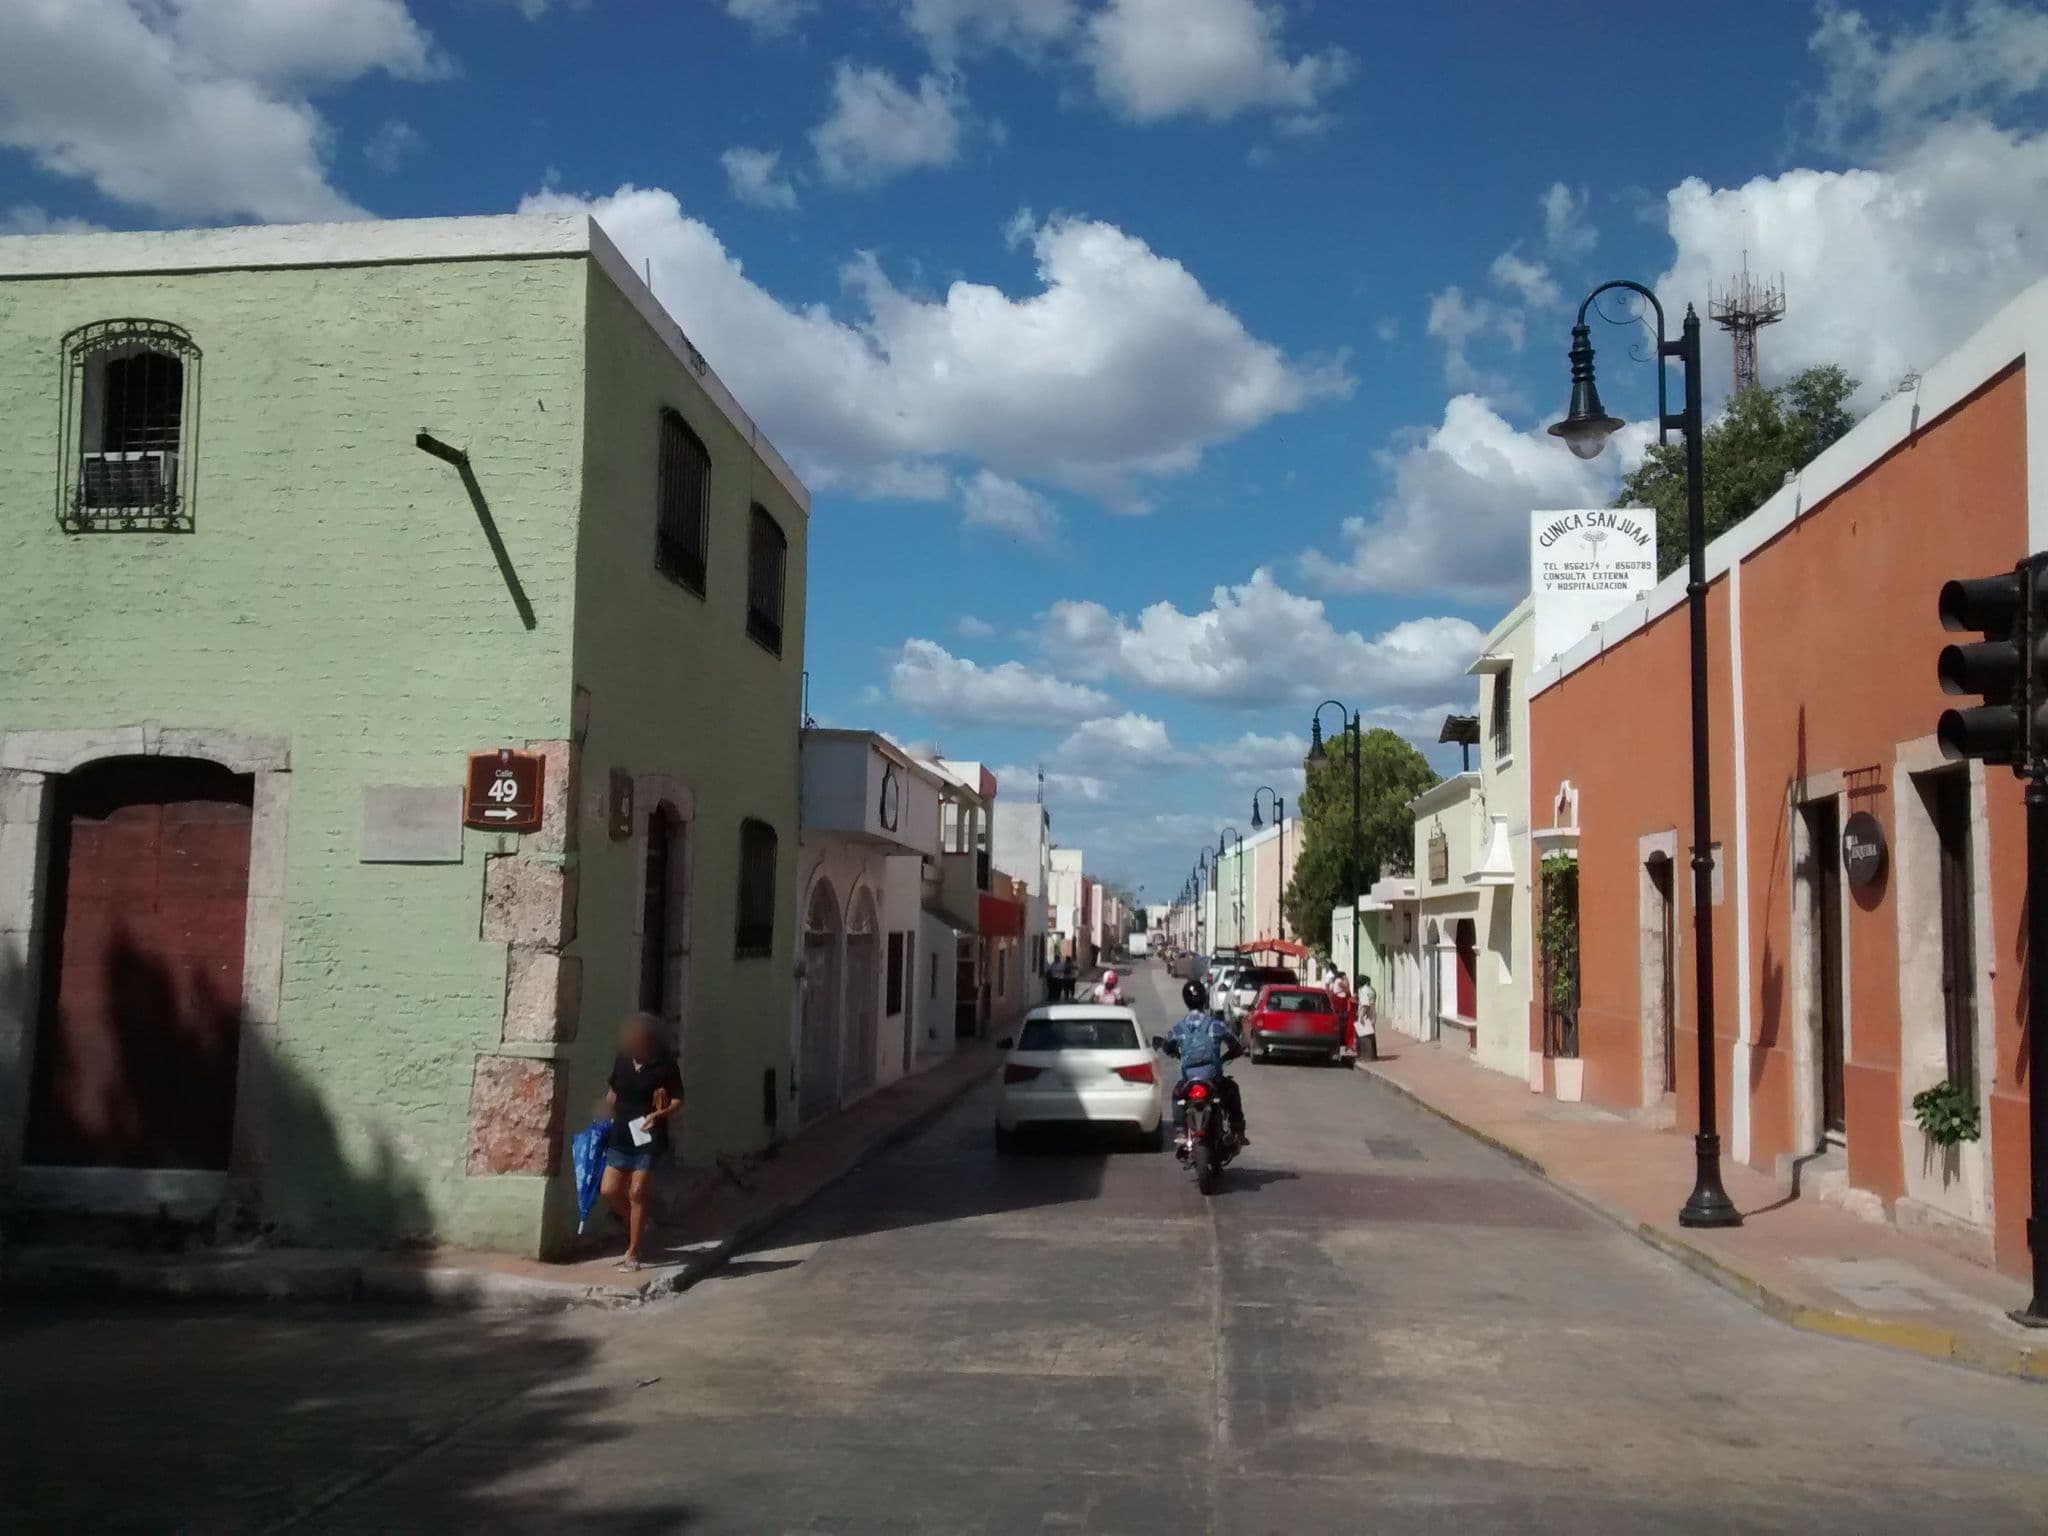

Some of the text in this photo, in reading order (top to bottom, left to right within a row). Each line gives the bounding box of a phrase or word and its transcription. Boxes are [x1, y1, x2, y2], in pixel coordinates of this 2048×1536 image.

[1540, 512, 1652, 547] CLINICA SAN JUAN
[1544, 562, 1558, 571] TEL
[1543, 572, 1629, 580] CONSULTA EXTERNA
[1557, 582, 1628, 590] HOSPITALIZACION
[495, 769, 513, 778] Calle
[488, 779, 518, 802] 49
